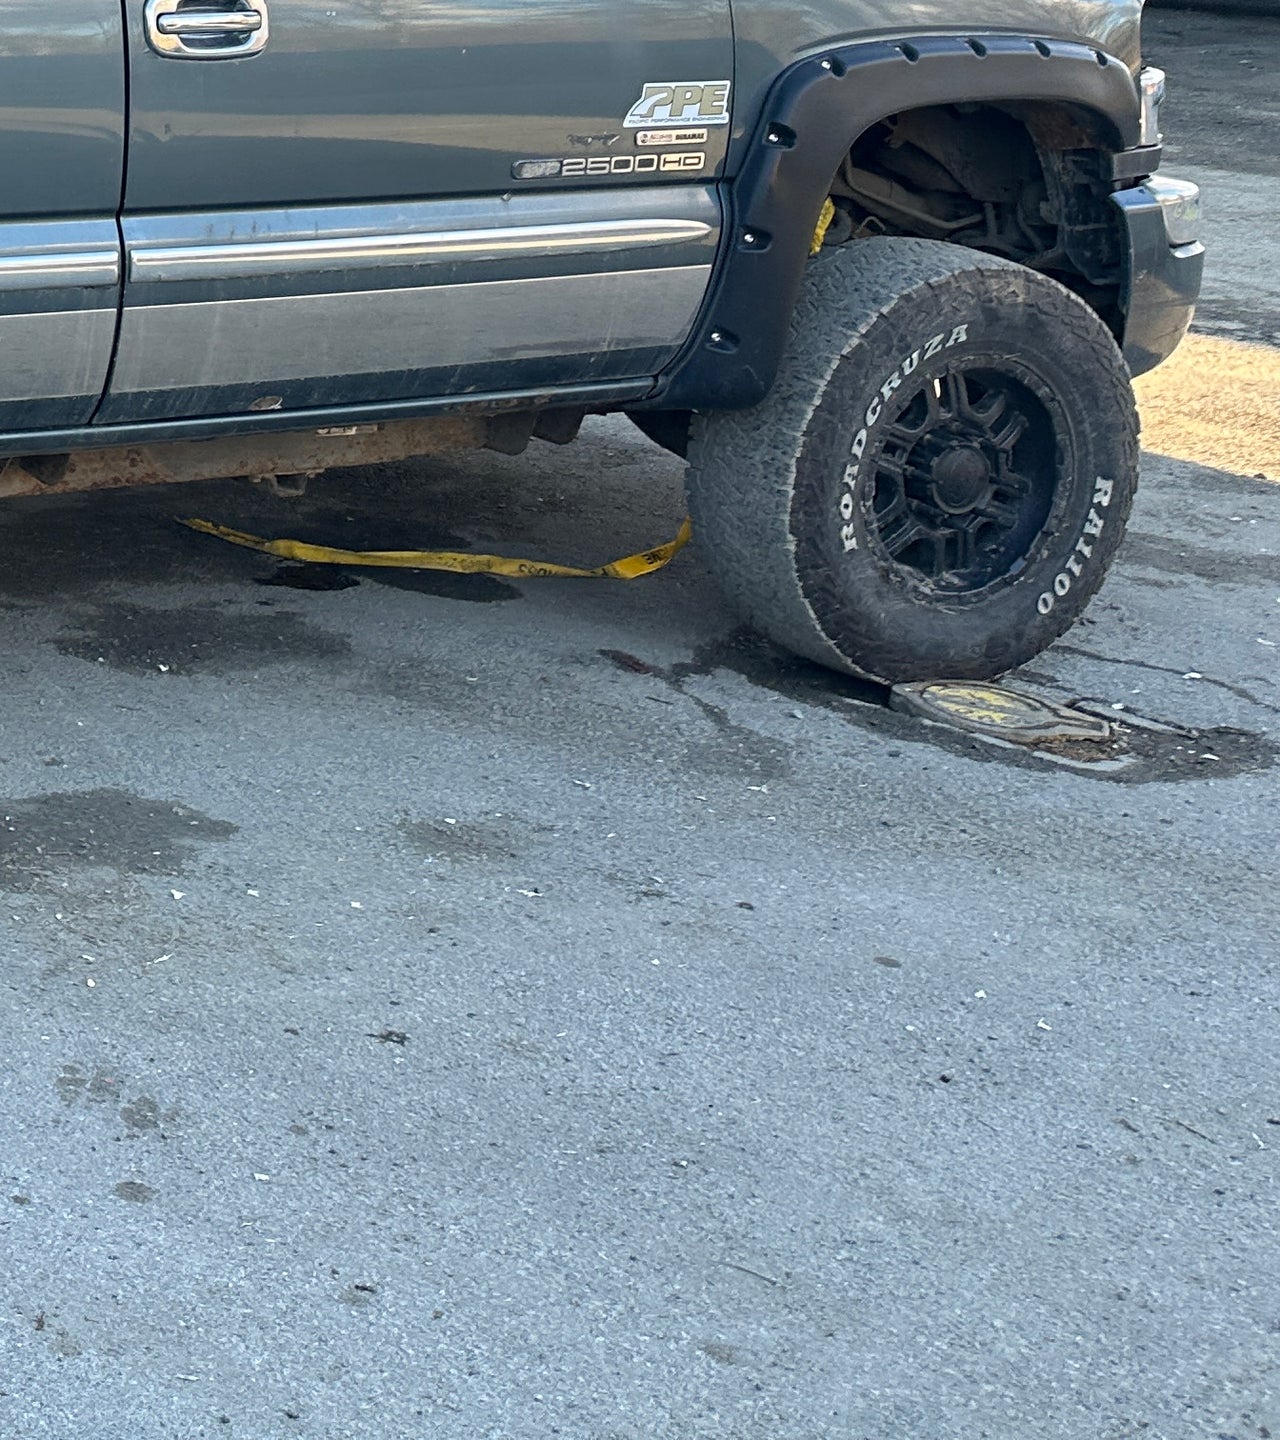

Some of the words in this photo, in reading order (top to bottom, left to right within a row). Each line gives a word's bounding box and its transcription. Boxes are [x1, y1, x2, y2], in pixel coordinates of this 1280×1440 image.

[630, 84, 728, 117] PPE
[839, 323, 968, 554] ROADCRUZA
[1036, 476, 1115, 615] RA1100
